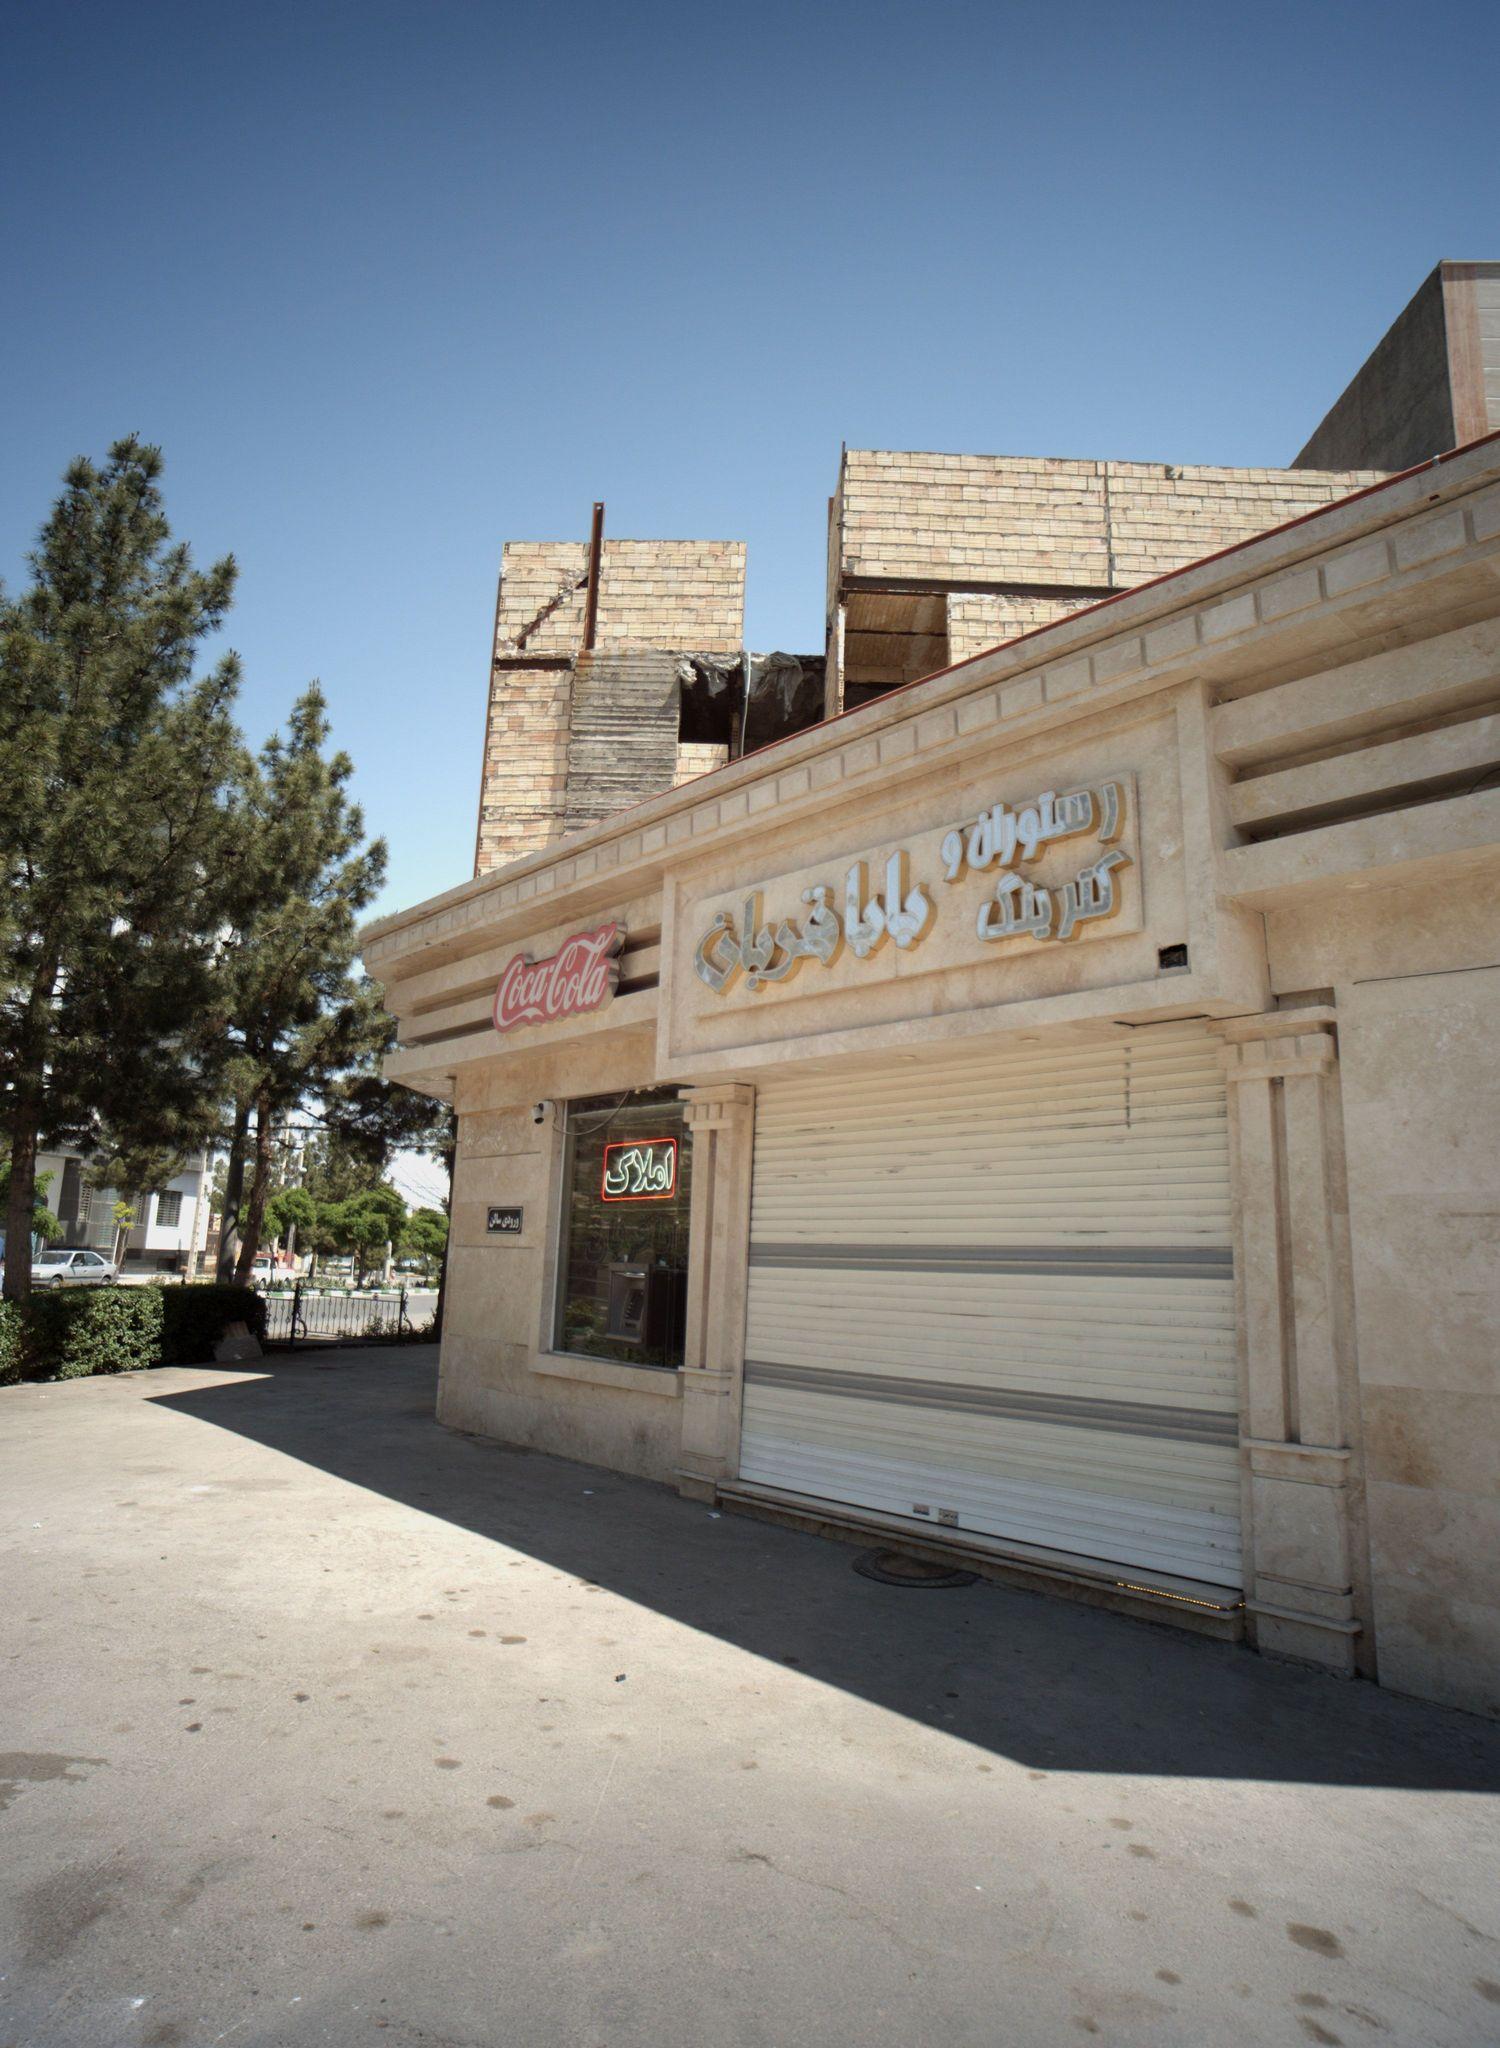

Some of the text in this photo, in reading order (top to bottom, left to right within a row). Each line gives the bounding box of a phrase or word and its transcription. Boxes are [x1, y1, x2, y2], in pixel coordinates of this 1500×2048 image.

[941, 782, 1120, 883] رستوران و
[693, 849, 934, 994] بابا قربان
[976, 849, 1132, 942] کترینگ
[496, 930, 615, 1027] Coca-Cola
[604, 1146, 674, 1194] املاک
